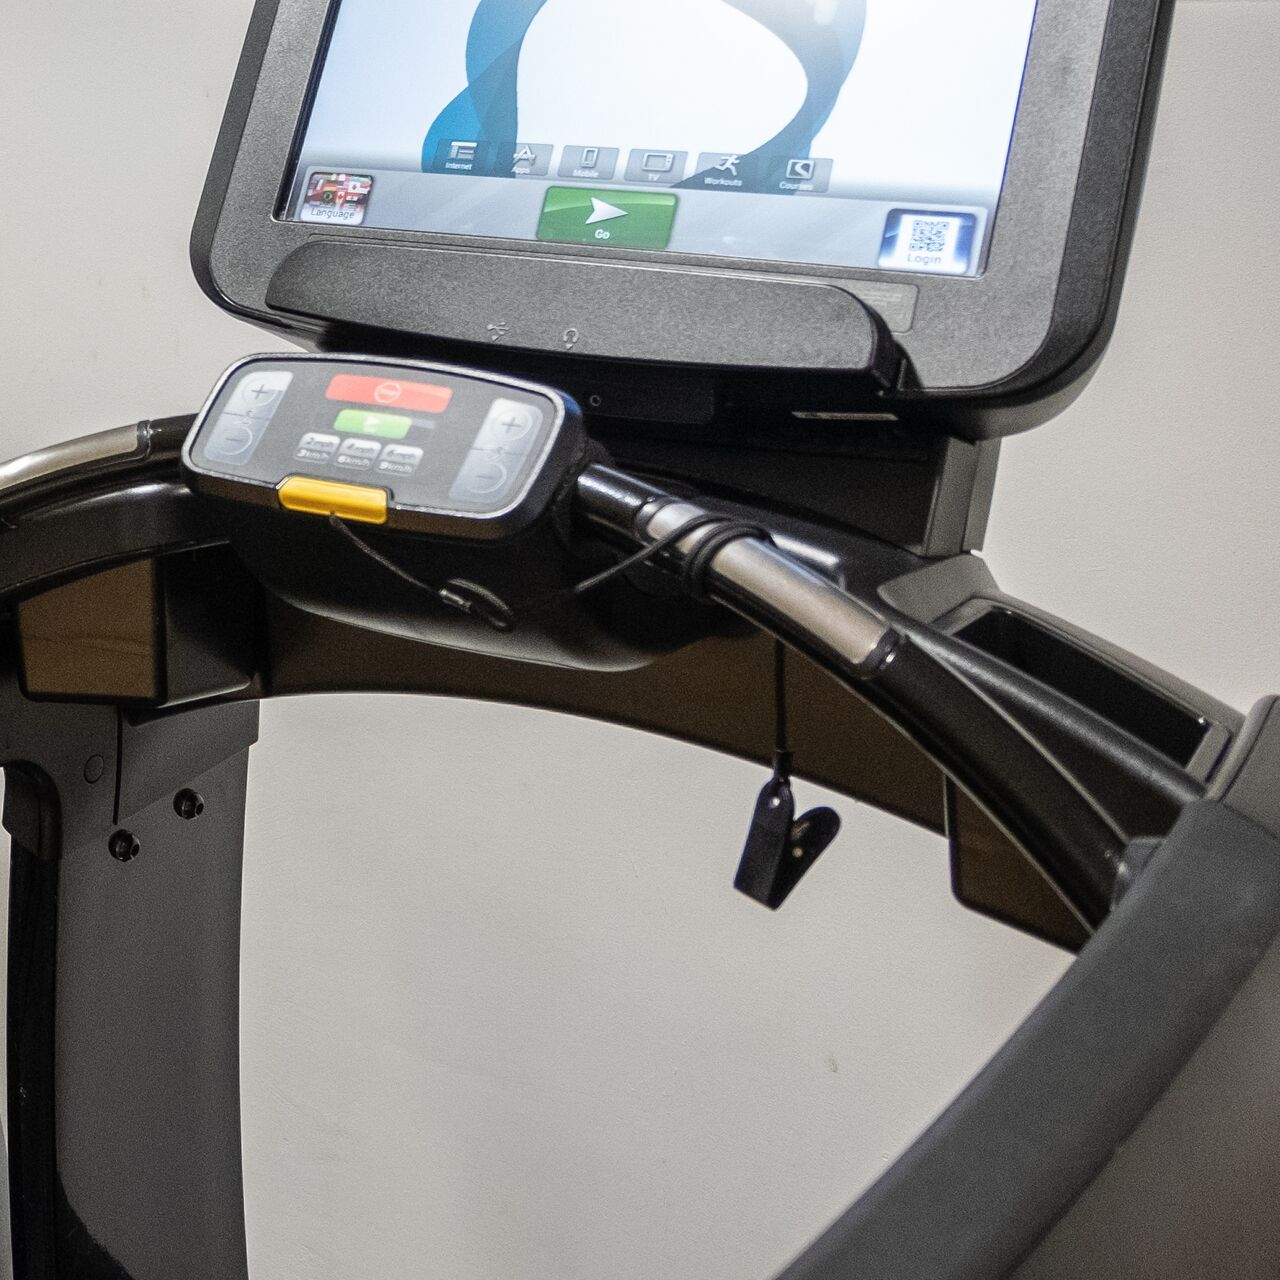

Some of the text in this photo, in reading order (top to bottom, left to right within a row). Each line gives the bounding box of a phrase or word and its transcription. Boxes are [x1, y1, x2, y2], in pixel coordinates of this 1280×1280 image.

[310, 208, 355, 220] Language
[594, 229, 610, 239] Go
[907, 254, 942, 265] Login
